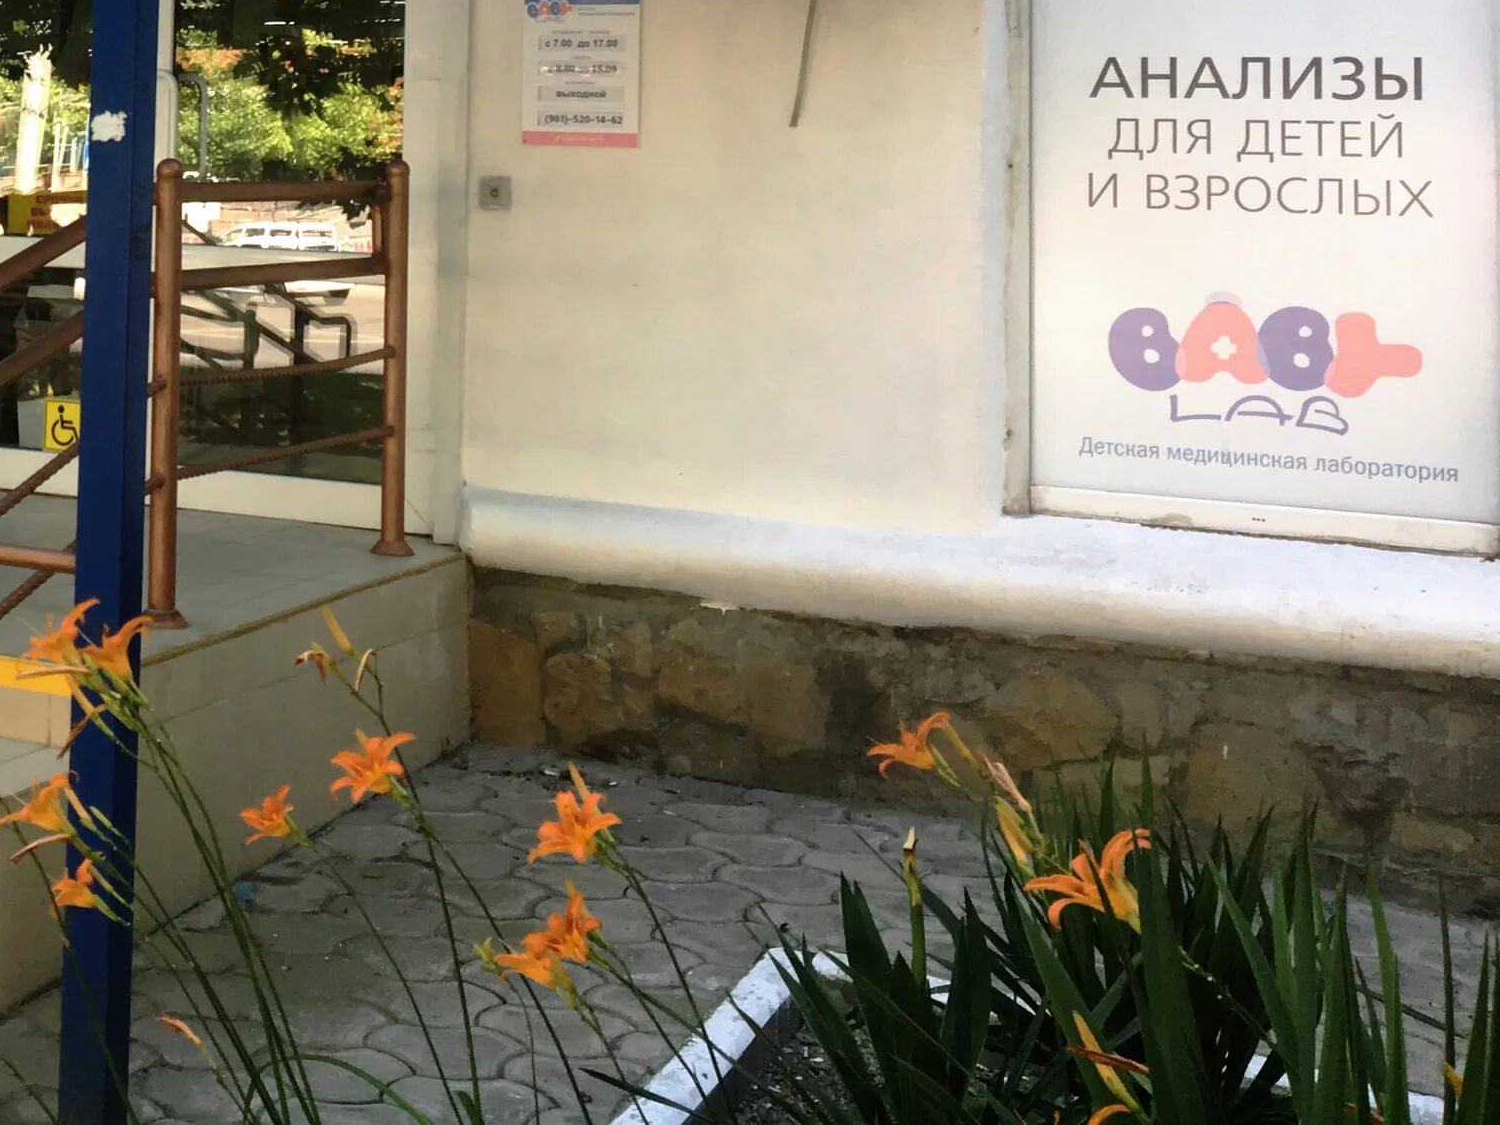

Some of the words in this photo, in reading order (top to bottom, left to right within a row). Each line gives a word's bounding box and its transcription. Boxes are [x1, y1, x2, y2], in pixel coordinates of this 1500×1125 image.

[1089, 56, 1424, 101] АНАЛИЗЫ
[1107, 117, 1212, 160] ДЛЯ
[1236, 113, 1403, 162] ДЕТЕЙ
[1088, 173, 1118, 208] И
[1145, 173, 1434, 218] ВЗРОСЛЫХ
[1108, 300, 1423, 398] BABY
[1170, 394, 1349, 435] LAB
[1078, 436, 1160, 459] Детская
[1167, 446, 1308, 471] медицинская
[1314, 455, 1459, 484] лаборатория
